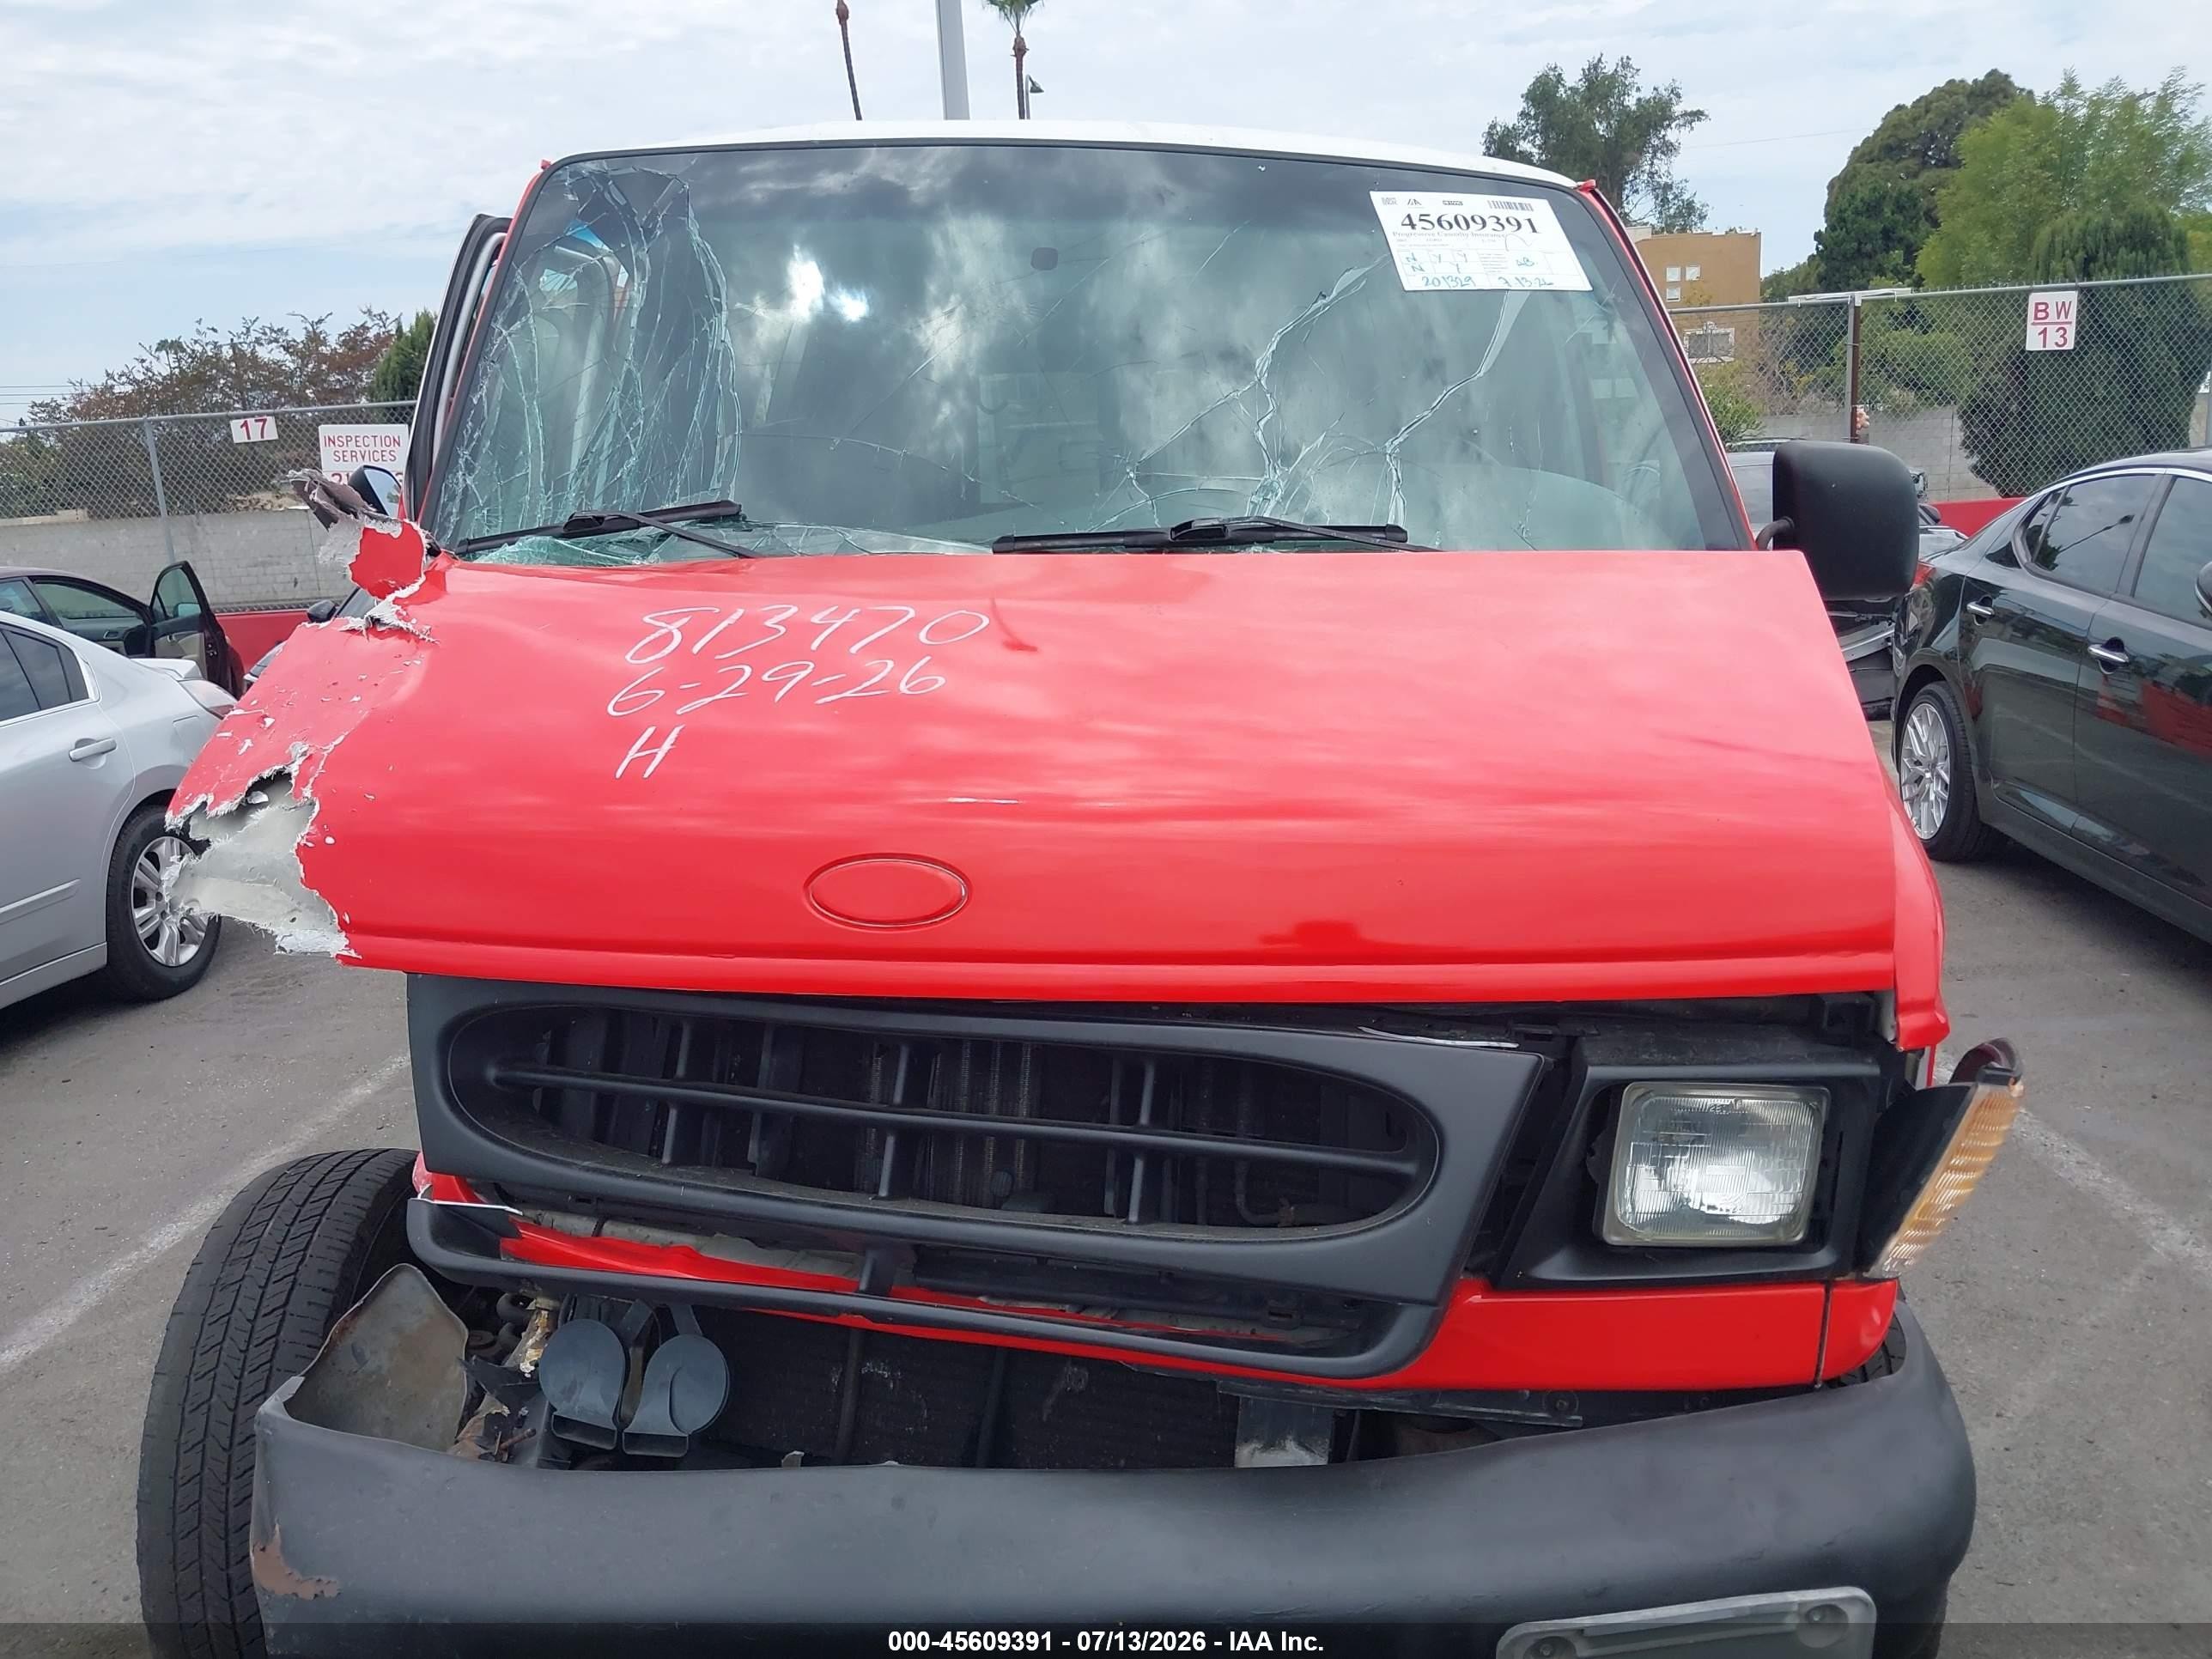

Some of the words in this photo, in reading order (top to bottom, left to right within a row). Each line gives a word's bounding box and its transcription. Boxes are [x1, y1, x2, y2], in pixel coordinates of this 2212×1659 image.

[1401, 213, 1540, 234] 45609391
[2038, 327, 2068, 349] 13
[240, 418, 268, 441] 17
[324, 434, 401, 447] INSPECTION
[333, 450, 397, 462] SERVICES
[625, 605, 990, 665] 813470
[607, 655, 945, 716] 6-29-26
[615, 725, 685, 779] H
